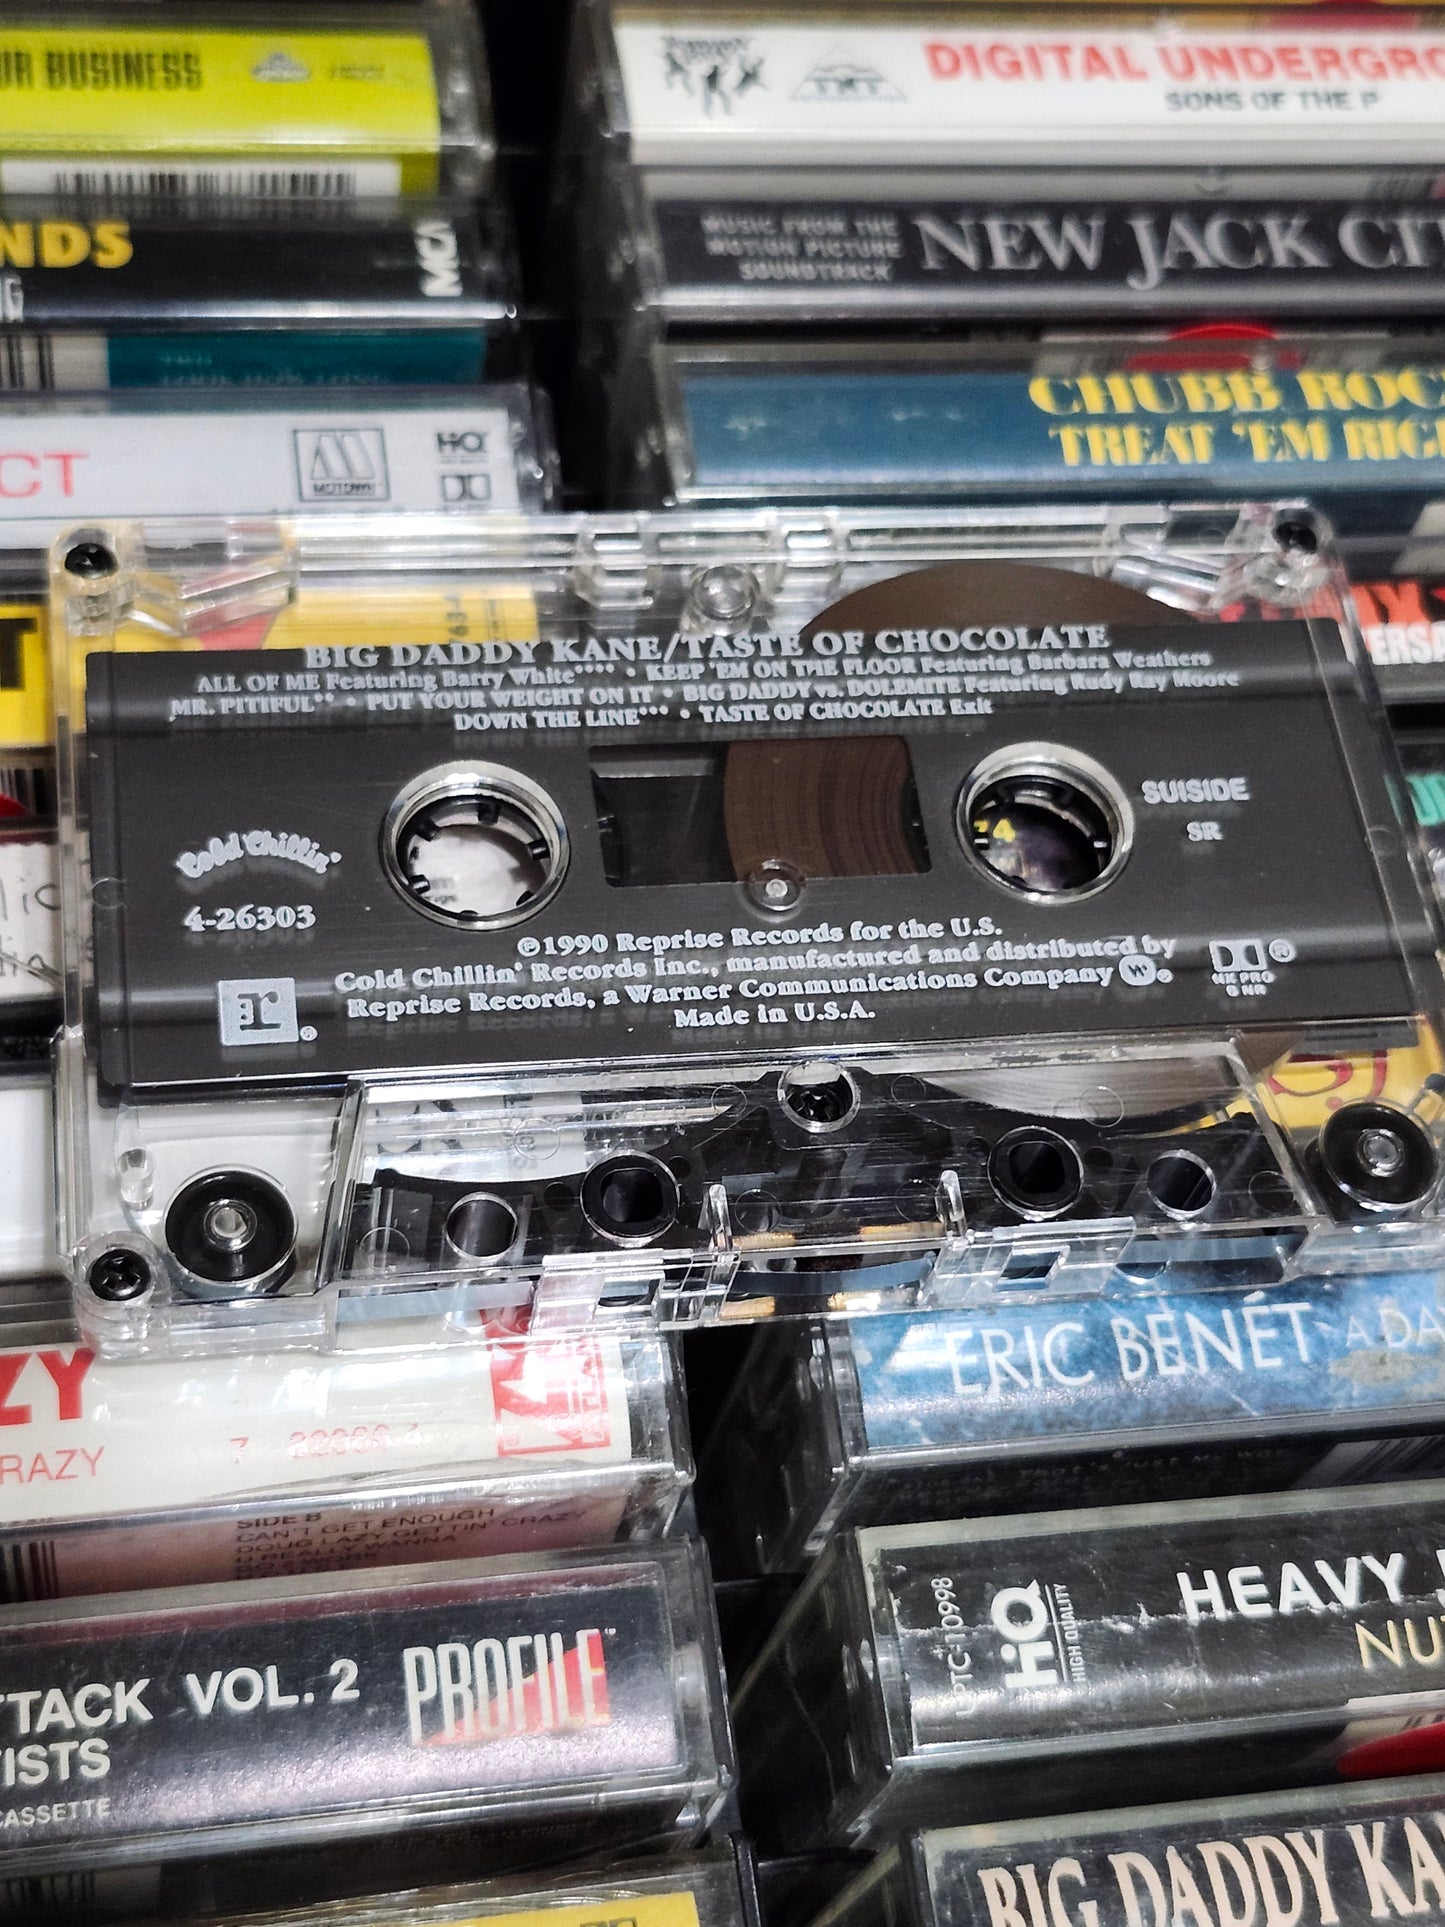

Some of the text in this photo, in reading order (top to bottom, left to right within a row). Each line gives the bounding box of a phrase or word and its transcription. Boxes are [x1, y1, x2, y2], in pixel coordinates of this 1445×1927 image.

[46, 51, 203, 92] BUSINESS
[923, 42, 1149, 82] DIGITAL
[1165, 90, 1380, 111] SONS OF THE P
[0, 221, 133, 268] NDS
[702, 215, 897, 235] MUSIC FROM THE
[706, 237, 901, 258] MOTION PICTURE
[912, 213, 1104, 271] NEW
[1127, 212, 1331, 290] JACK
[739, 261, 892, 281] SOUNDTRACK
[1029, 369, 1445, 415] CHUBB ROC
[1049, 421, 1214, 466] TREAT
[0, 449, 88, 499] CT
[304, 624, 1111, 669] BIG DADDY KANE/TASTE OF CHOCOLATE
[170, 698, 216, 717] MR.
[367, 693, 419, 711] PUT
[419, 690, 486, 710] YOUR
[490, 688, 584, 708] WEIGHT
[589, 686, 623, 705] ON
[629, 685, 653, 704] IT
[683, 683, 724, 702] BIG
[729, 681, 812, 701] DADDY
[814, 683, 844, 699] vs.
[847, 676, 961, 697] DOLEMITE
[964, 673, 1068, 696] Featuring
[1071, 670, 1124, 694] Rudy
[1129, 670, 1168, 693] Ray
[1172, 668, 1241, 688] Moore
[197, 674, 241, 693] ALL
[247, 674, 280, 692] OF
[286, 673, 320, 691] ME
[326, 671, 437, 692] Featuring
[442, 667, 504, 690] Barry
[646, 663, 705, 681] KEEP
[709, 662, 749, 679] 'EM
[753, 661, 788, 678] ON
[791, 659, 840, 677] THE
[844, 657, 917, 676] FLOOR
[920, 653, 1024, 675] Featuring
[1028, 650, 1111, 671] Barbara
[1113, 649, 1213, 669] Weathers
[453, 712, 529, 732] DOWN
[532, 709, 581, 729] THE
[699, 703, 770, 723] TASTE
[773, 702, 804, 721] OF
[808, 697, 946, 721] CHOCOLATE
[1142, 777, 1250, 804] SUISIDE
[1186, 820, 1223, 842] SR
[184, 904, 316, 932] 4-26303
[616, 929, 724, 956] Reprise
[731, 923, 844, 947] Records
[850, 920, 893, 942] for
[898, 919, 944, 939] the
[950, 917, 1003, 938] U.S.
[335, 934, 1176, 993] Cold Chillin' Records Inc., manufactured and distributed by
[347, 961, 1113, 1022] Reprise Records, a Warner Communications Company
[674, 1000, 876, 1028] Made in U.S.A.
[944, 1322, 1096, 1395] ERIC
[1110, 1290, 1312, 1383] BENÉT
[1379, 1304, 1445, 1348] DA
[0, 1446, 104, 1485] RAZY
[237, 1512, 322, 1530] SIDE B
[237, 1507, 495, 1543] CAN'T GET ENOUGH
[501, 1510, 588, 1527] CRAZY
[365, 1533, 456, 1550] WANNA
[1176, 1552, 1404, 1626] HEAVY
[1052, 1583, 1087, 1682] HIGH QUALITY
[1355, 1615, 1445, 1671] NU
[0, 1658, 361, 1735] TACK VOL. 2
[402, 1628, 611, 1746] PROFILE
[0, 1737, 111, 1787] ISTS
[978, 1811, 1445, 1927] BIG DADDY KA
